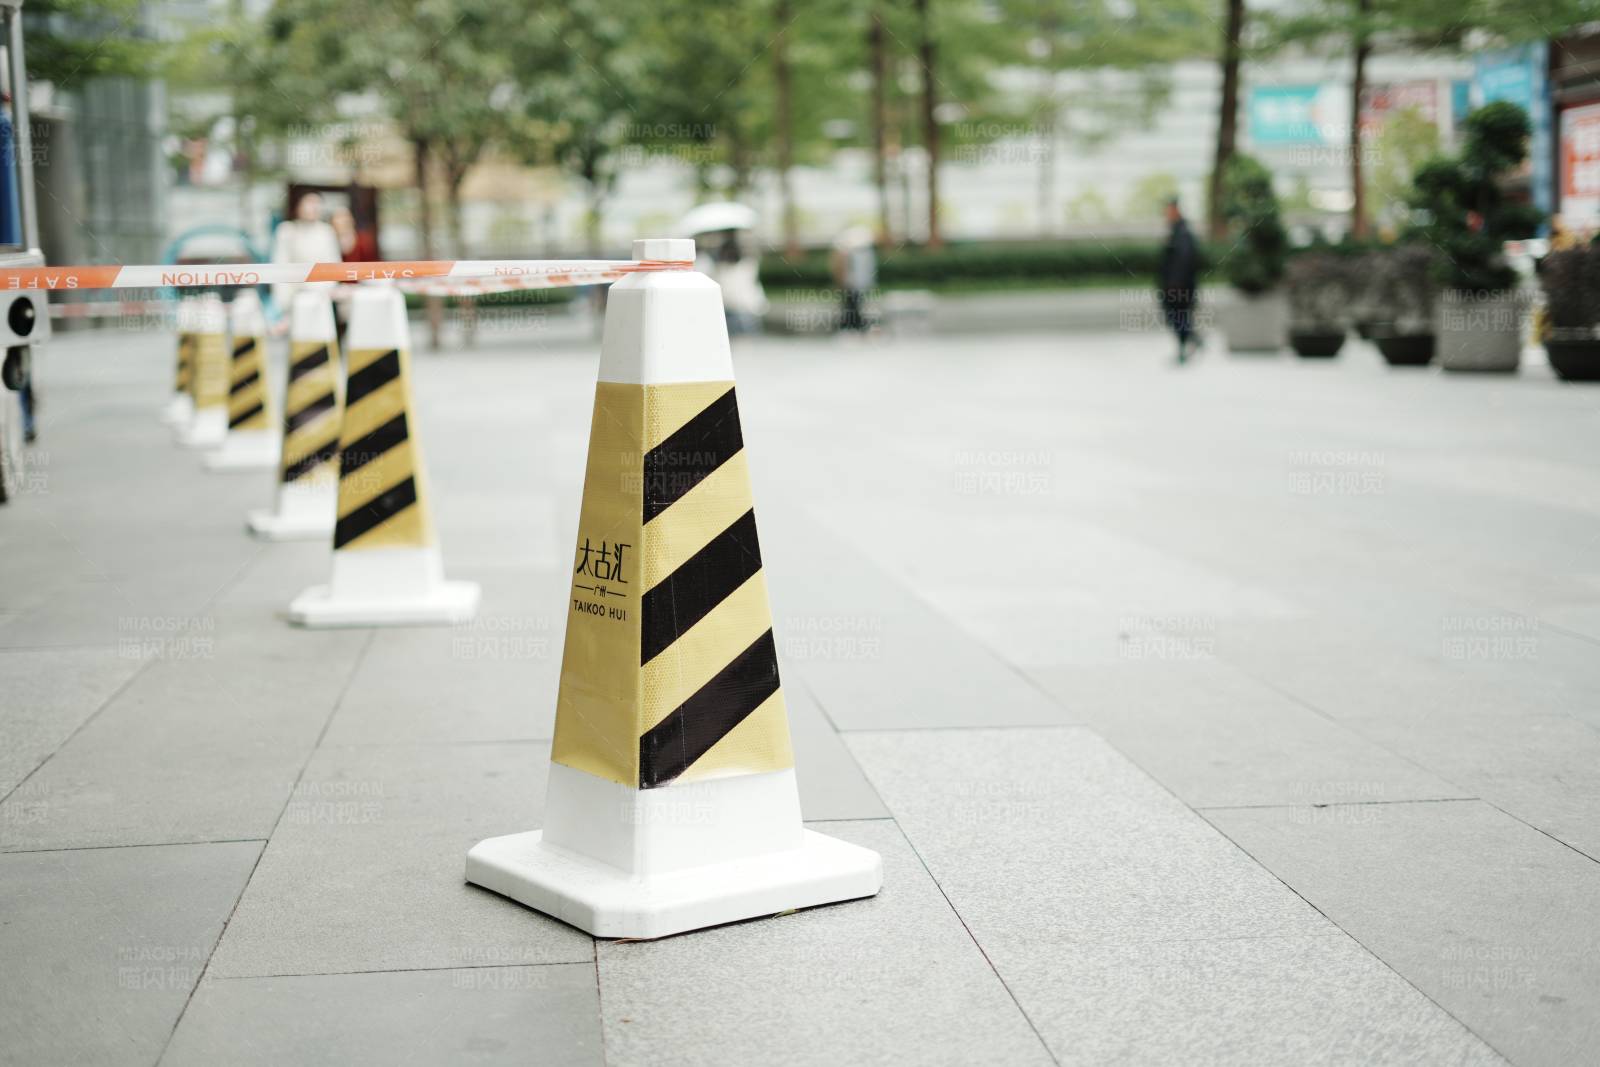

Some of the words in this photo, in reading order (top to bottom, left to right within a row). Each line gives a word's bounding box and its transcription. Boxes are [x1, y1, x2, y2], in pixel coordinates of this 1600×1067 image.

[8, 276, 78, 289] SAFE
[162, 272, 260, 286] CAUTION
[576, 537, 632, 584] 太古汇
[573, 599, 606, 617] TAIKOO
[609, 607, 626, 622] HUI
